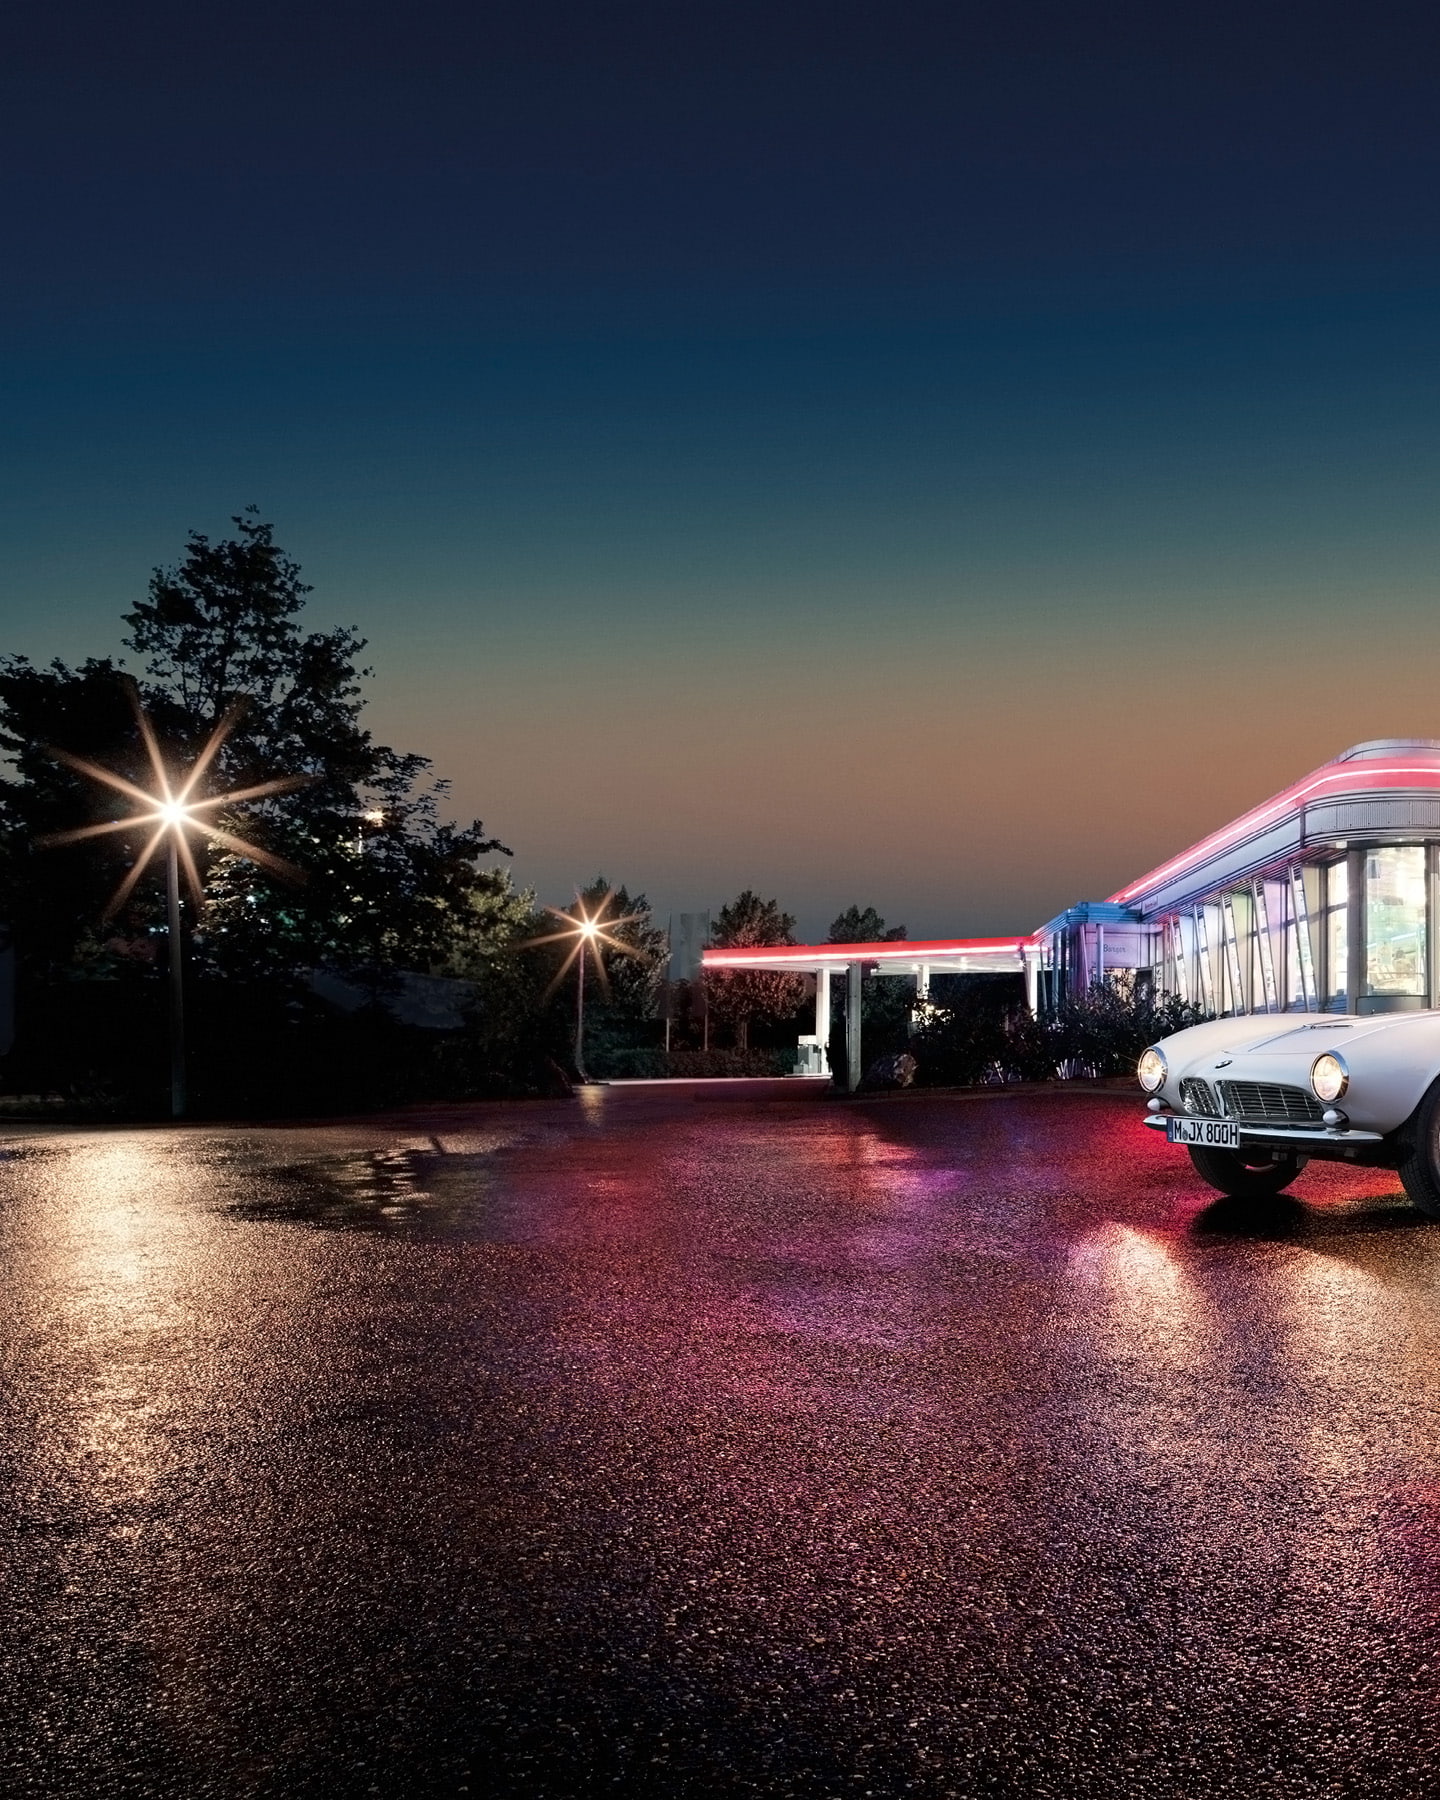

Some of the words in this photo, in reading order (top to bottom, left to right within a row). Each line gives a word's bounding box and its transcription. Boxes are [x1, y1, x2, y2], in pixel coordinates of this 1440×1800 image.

[1174, 1120, 1182, 1140] M
[1188, 1121, 1204, 1142] JX
[1206, 1122, 1238, 1146] 800H
